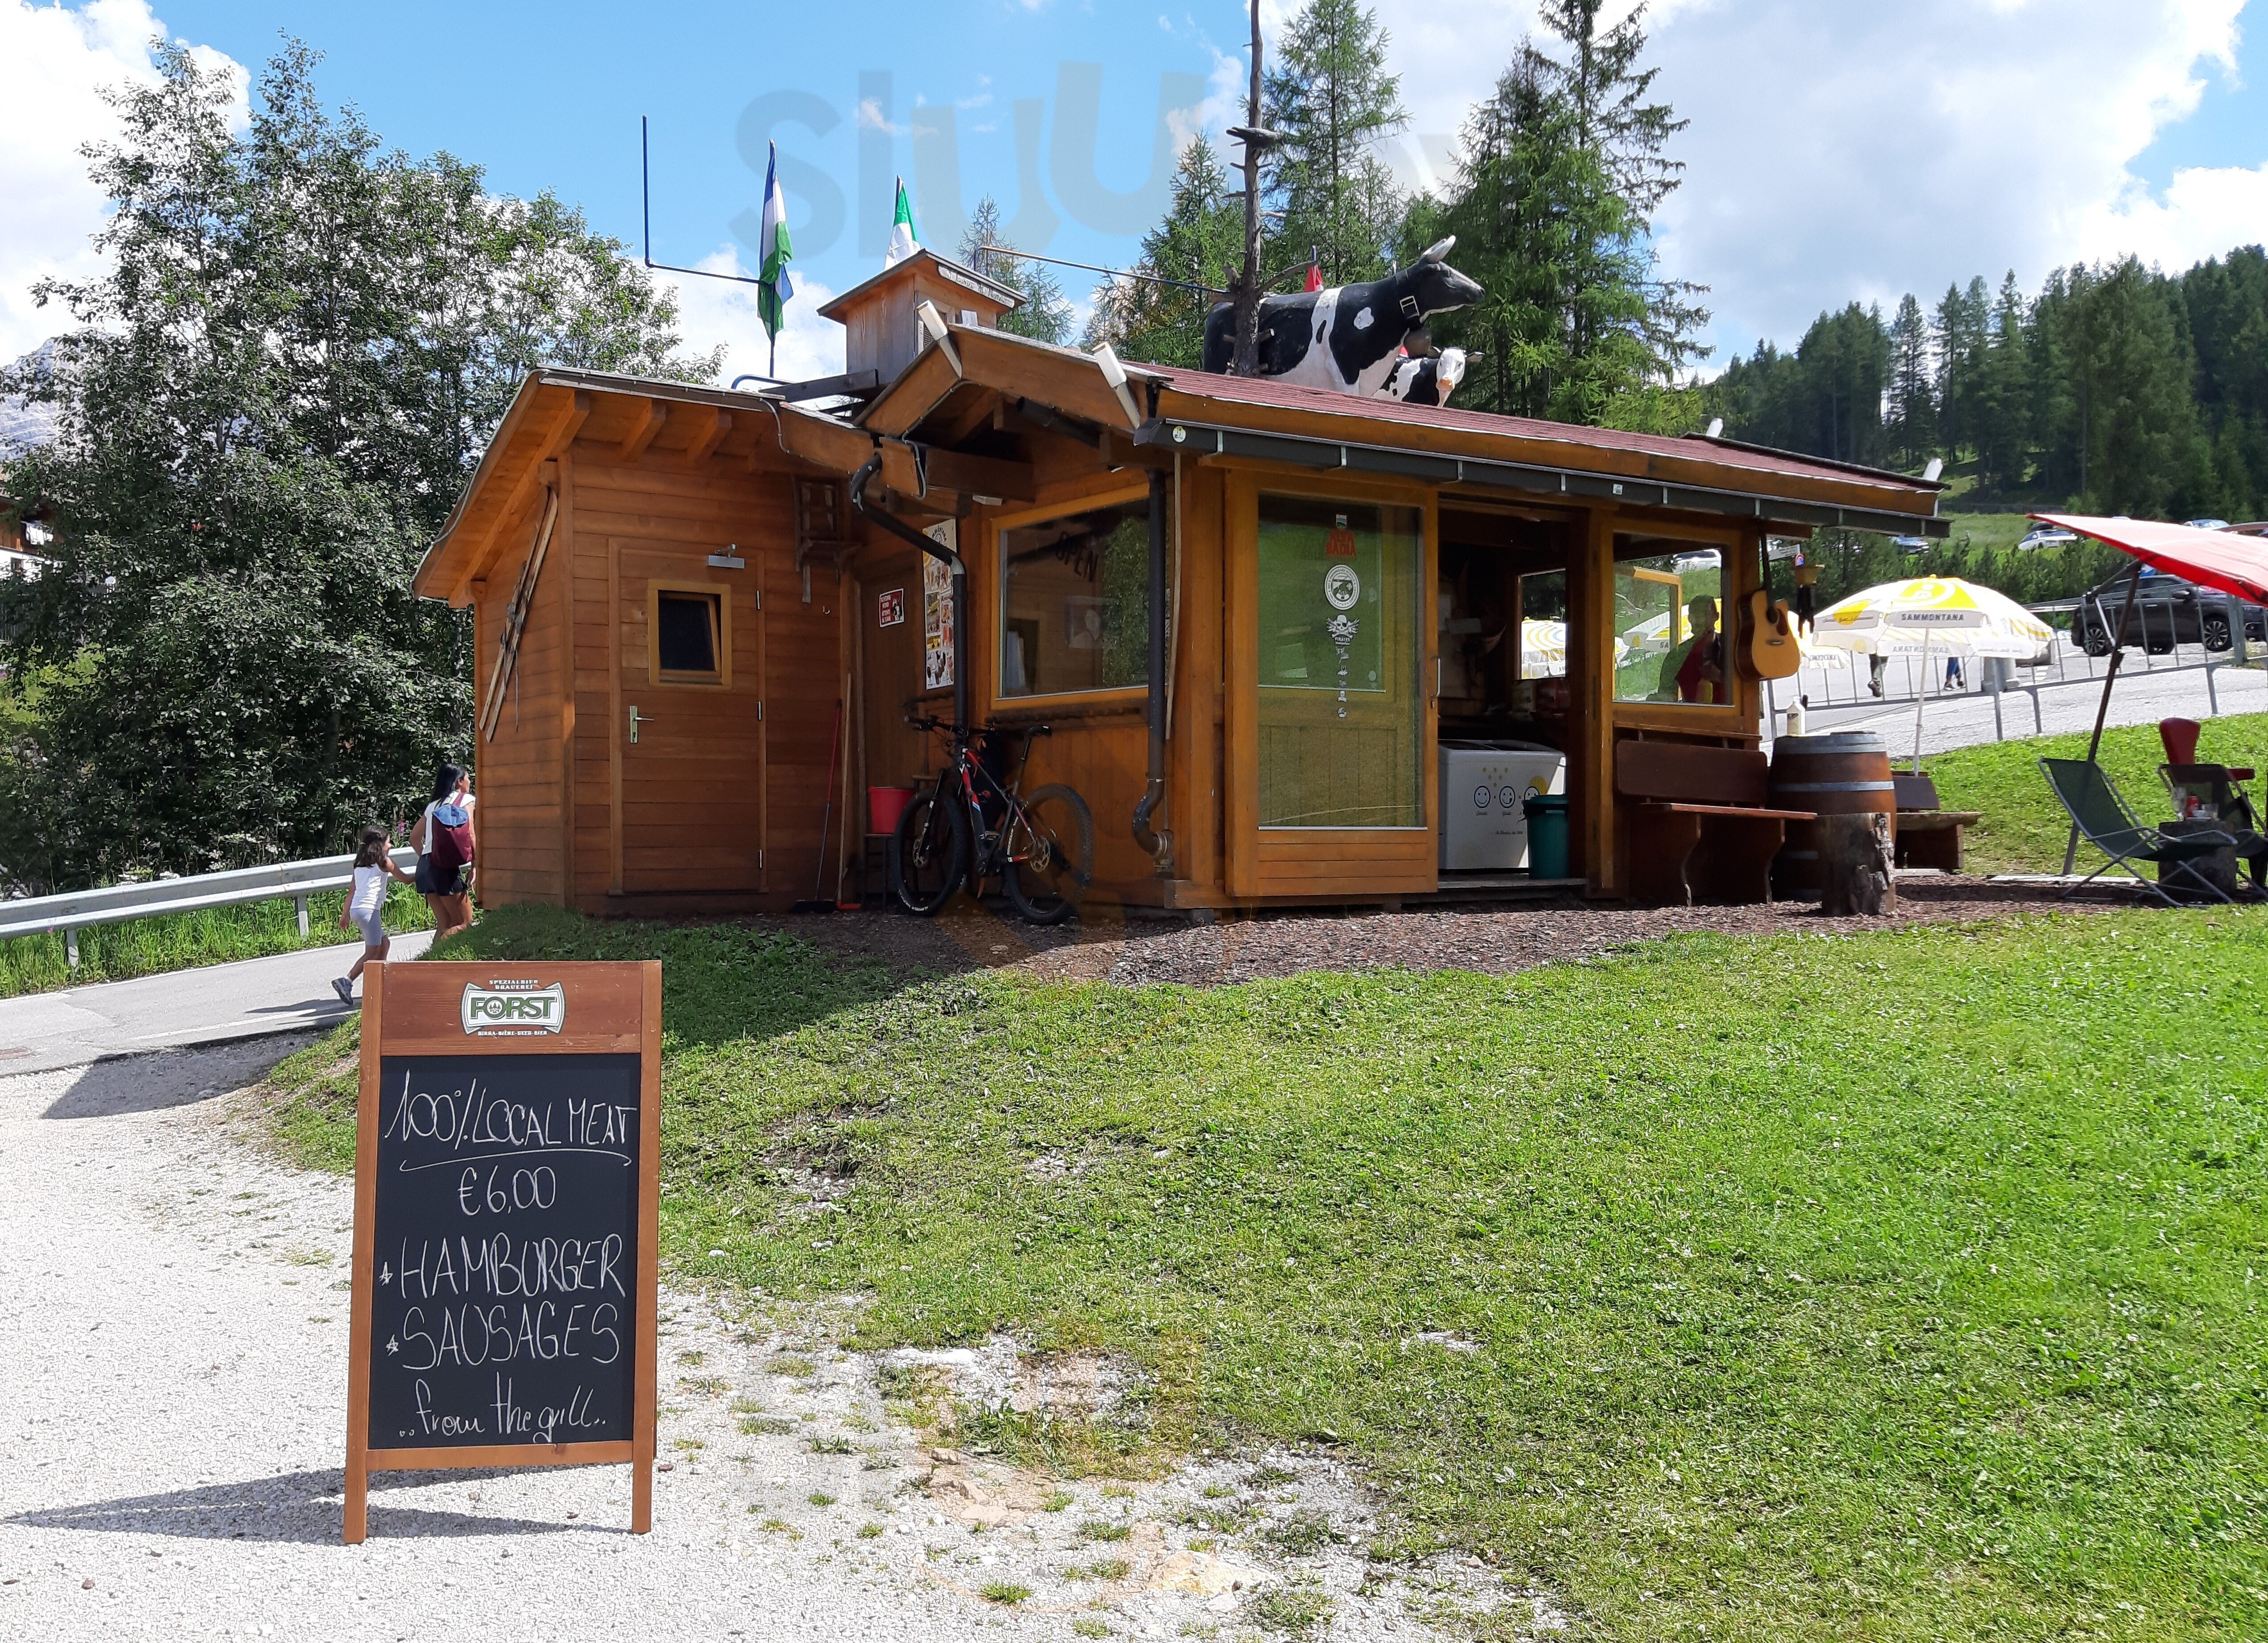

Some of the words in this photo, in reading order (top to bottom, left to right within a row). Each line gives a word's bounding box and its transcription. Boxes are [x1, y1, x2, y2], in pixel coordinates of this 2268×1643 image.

[1901, 613, 1964, 621] SAMMONTANA
[470, 996, 557, 1020] FORST
[473, 1087, 562, 1146] LOCAL
[568, 1097, 637, 1145] MEAT
[400, 1232, 626, 1299] HAMBURGER
[402, 1301, 620, 1370] SAUSAGES
[490, 1371, 531, 1435] the
